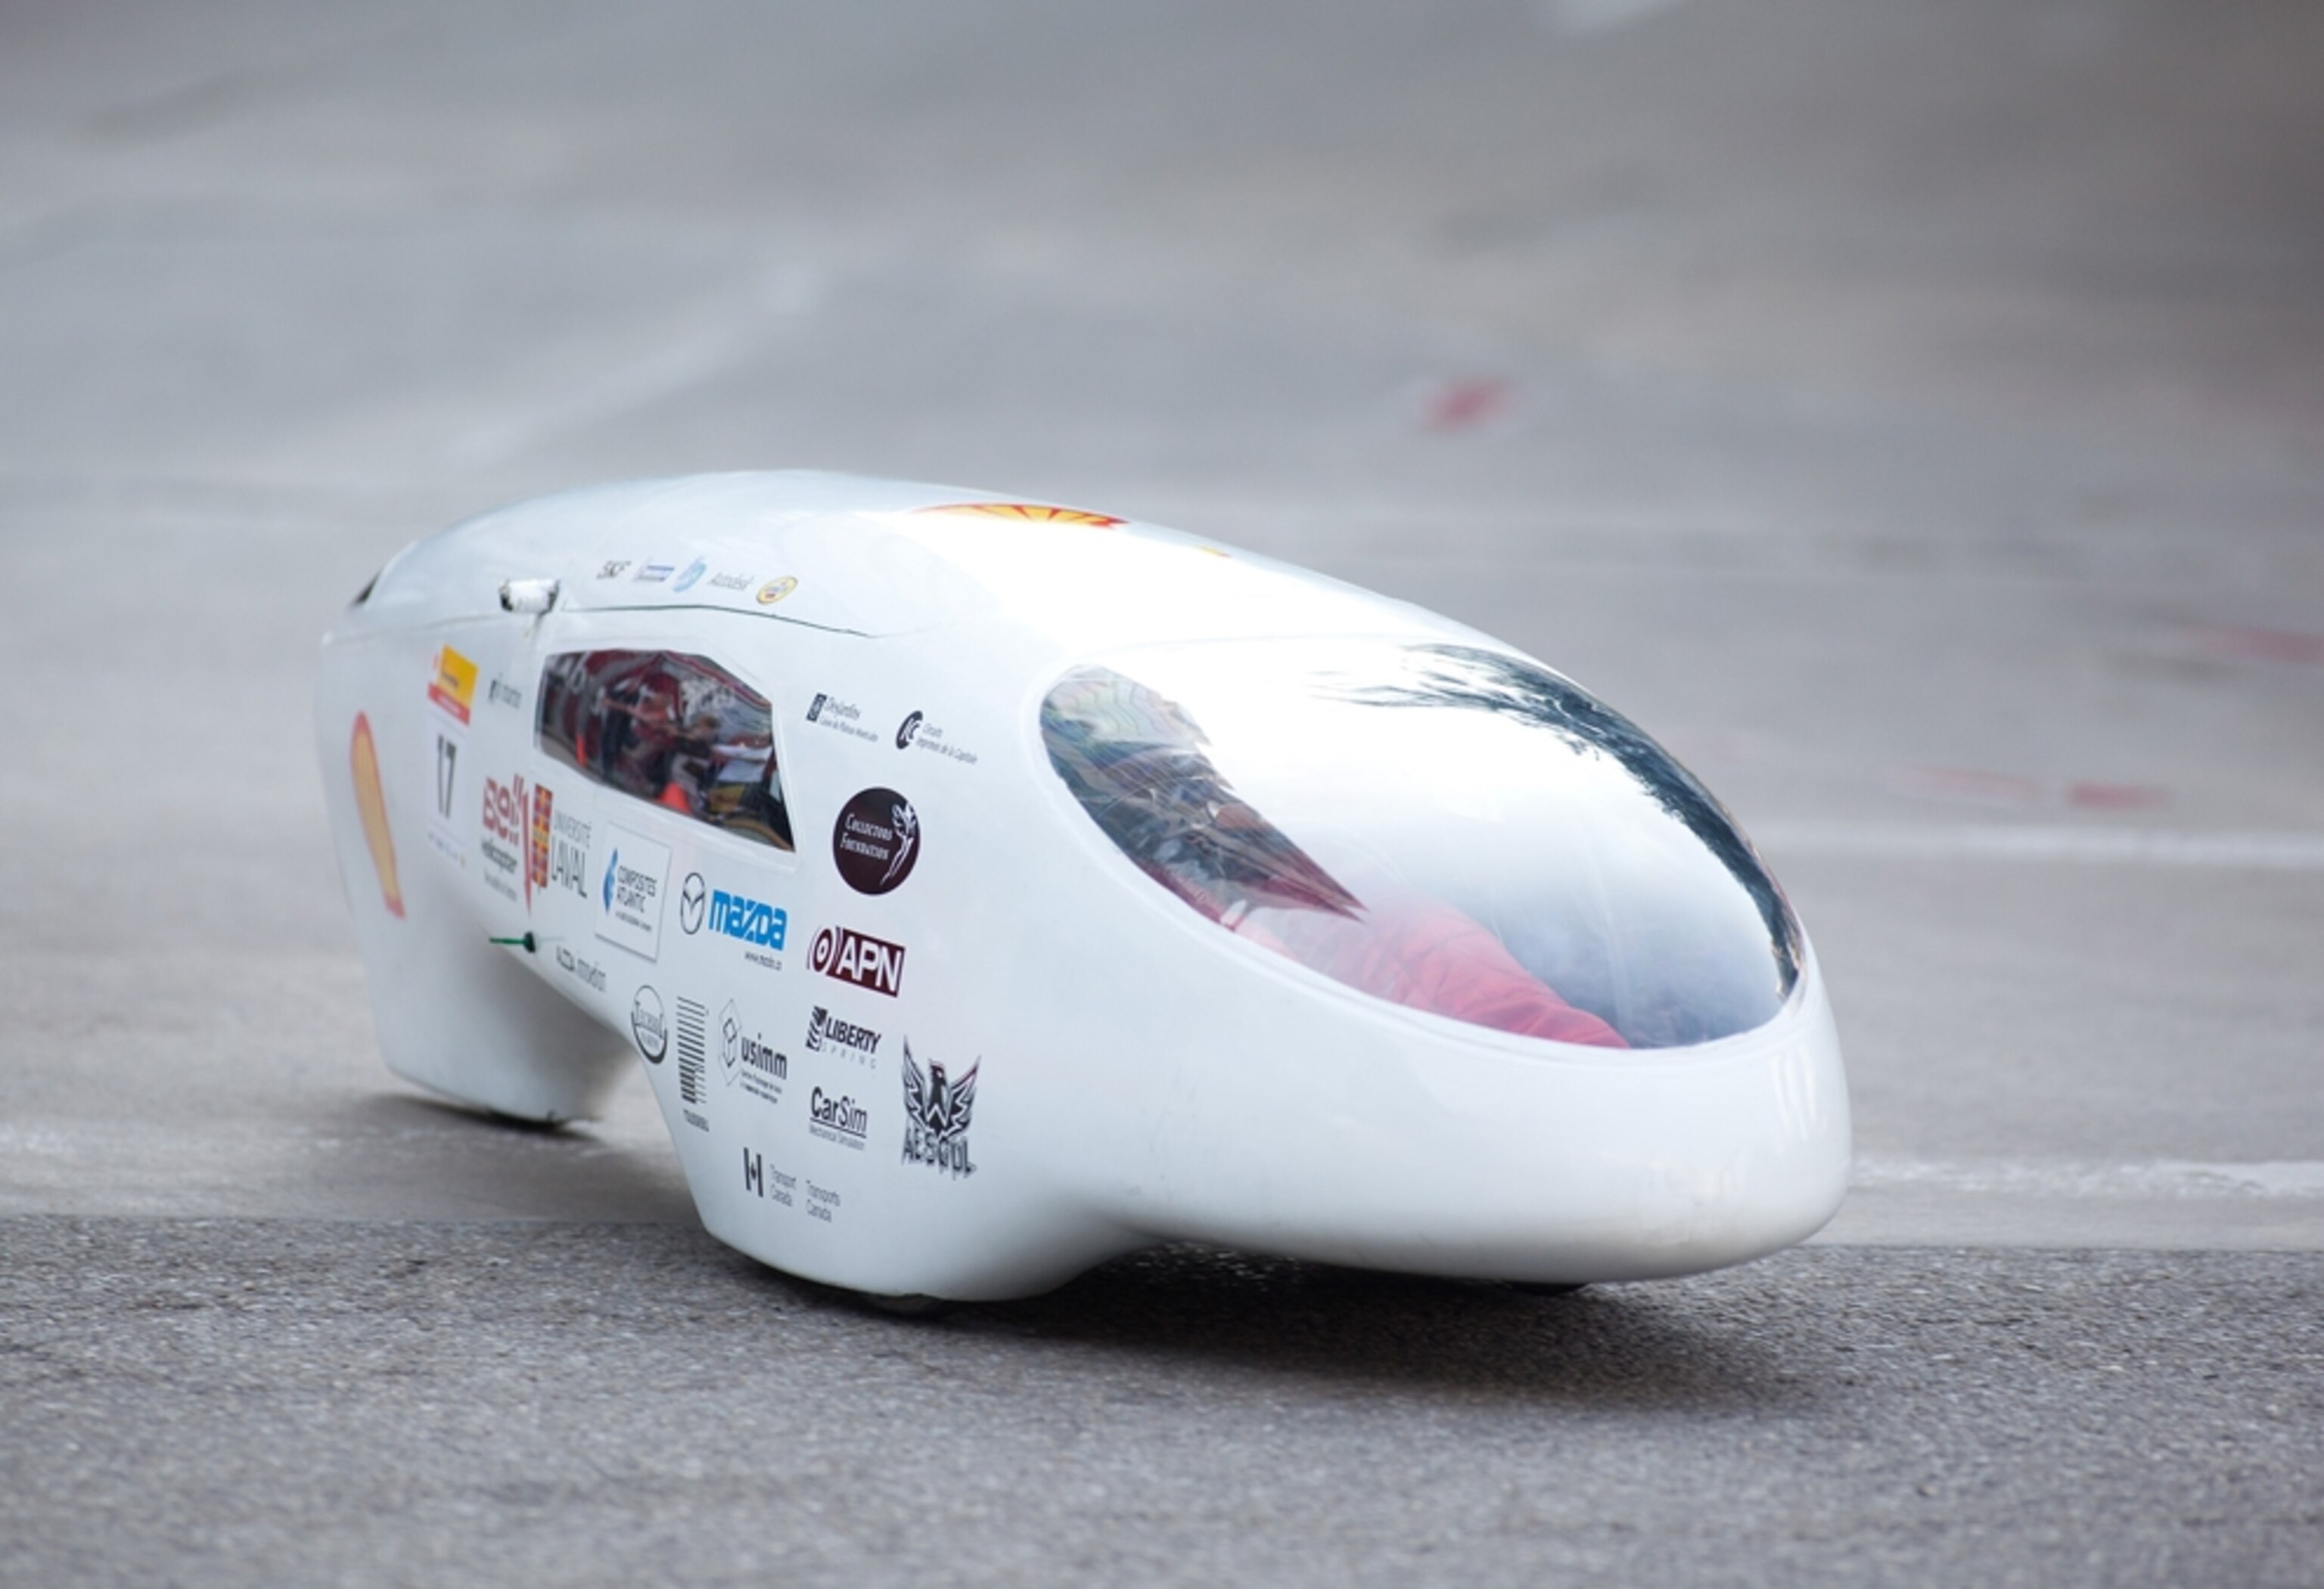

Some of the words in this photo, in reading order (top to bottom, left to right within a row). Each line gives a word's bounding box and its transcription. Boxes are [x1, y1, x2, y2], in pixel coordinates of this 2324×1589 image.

[437, 734, 457, 819] 17
[551, 835, 587, 899] LAVAL
[709, 889, 788, 951] mazda
[835, 935, 903, 992] APN
[741, 1032, 788, 1080] usimm
[825, 1016, 881, 1054] LIBERTY
[811, 1086, 867, 1133] CarSim
[771, 1184, 793, 1207] Canada
[806, 1199, 831, 1224] Canada
